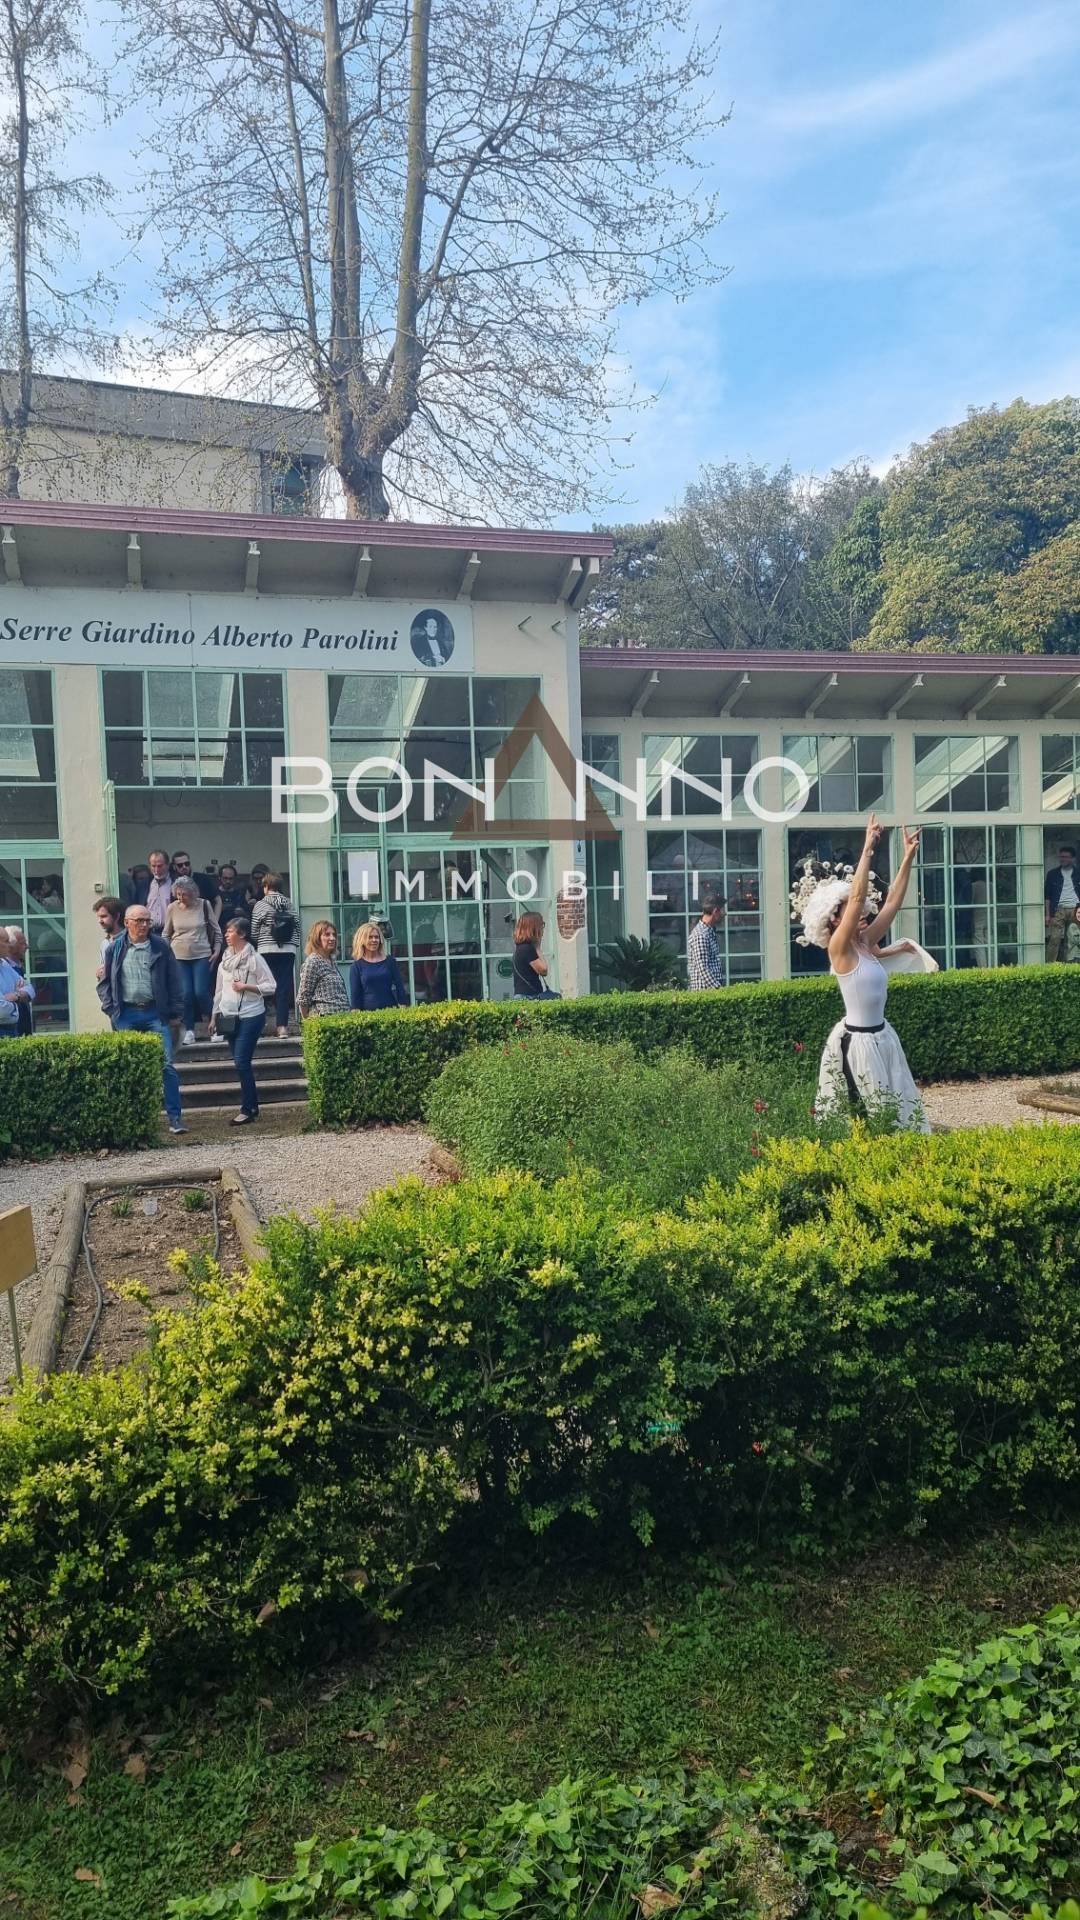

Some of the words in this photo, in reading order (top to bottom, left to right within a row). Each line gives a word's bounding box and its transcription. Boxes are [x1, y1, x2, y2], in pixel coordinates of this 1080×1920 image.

[0, 618, 72, 641] Serre
[82, 620, 196, 646] Giardino
[201, 625, 294, 649] Alberto
[301, 627, 399, 651] Parolini
